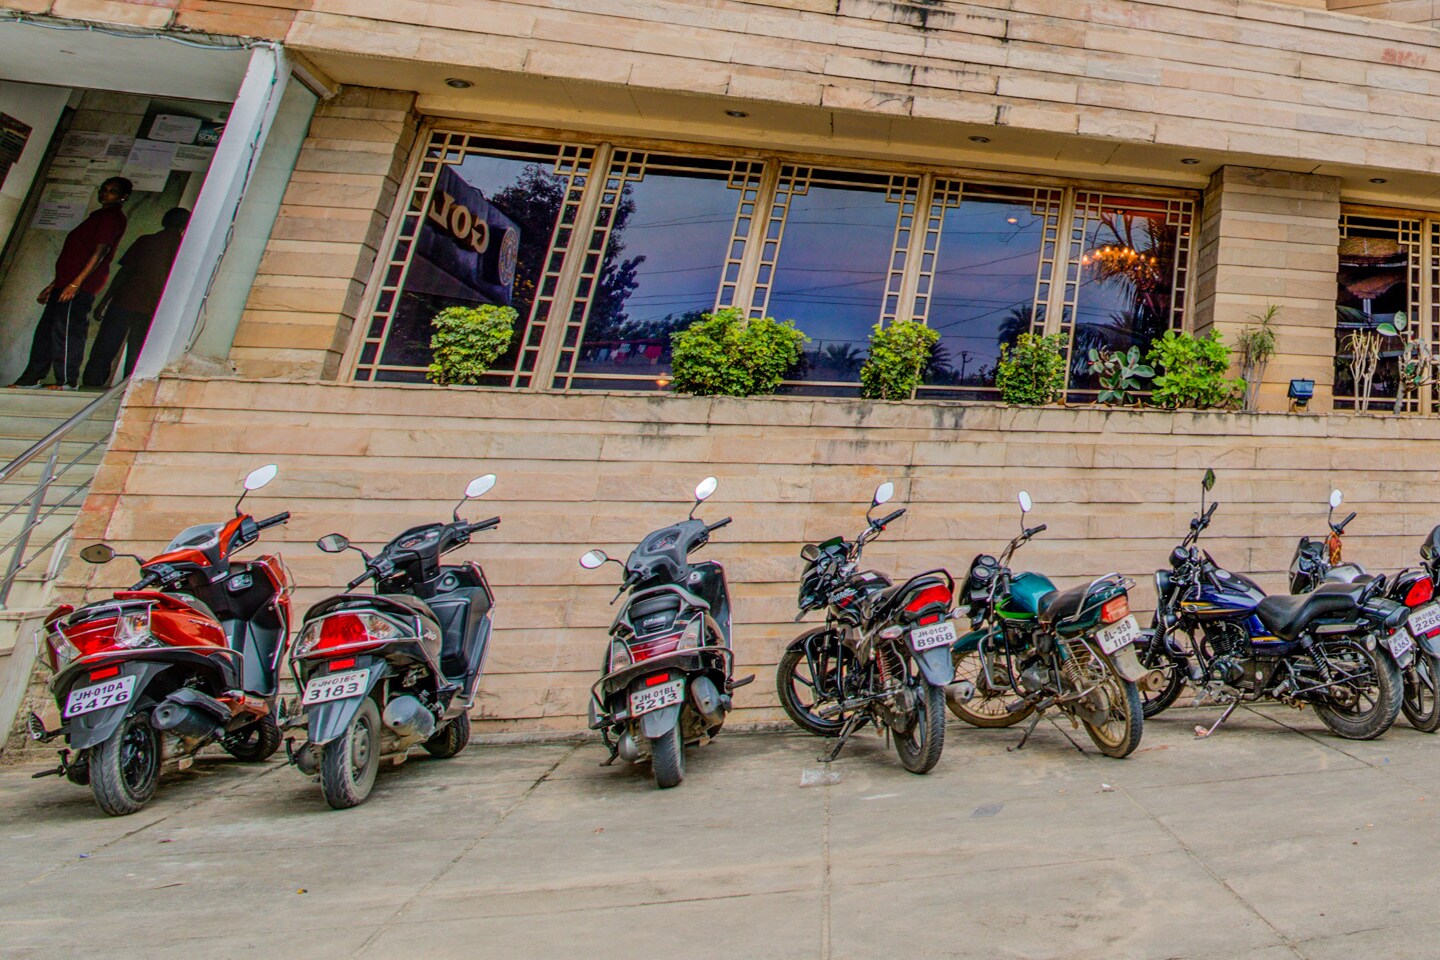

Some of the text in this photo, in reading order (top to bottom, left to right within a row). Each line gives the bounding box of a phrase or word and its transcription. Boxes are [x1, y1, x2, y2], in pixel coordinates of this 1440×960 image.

[917, 632, 954, 648] 8968
[309, 682, 359, 700] 3183
[69, 691, 129, 713] 6476
[635, 693, 677, 713] 5213
